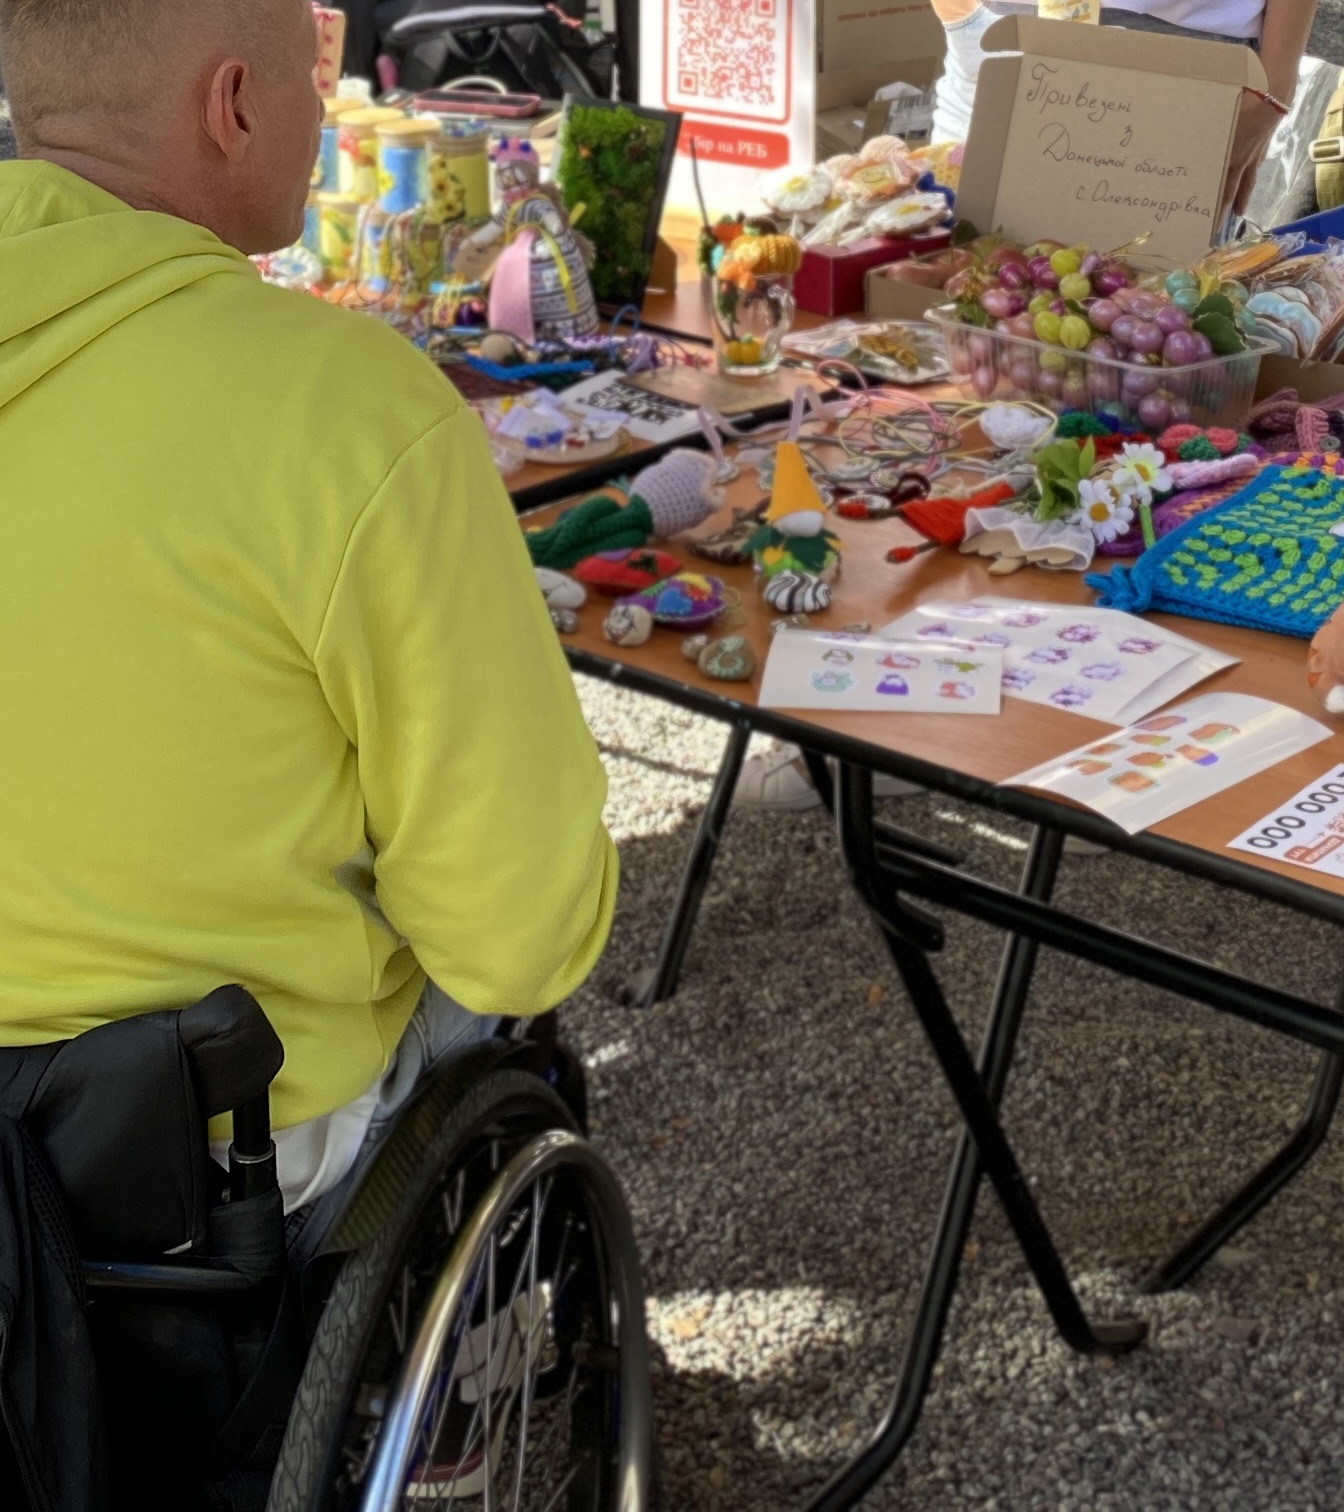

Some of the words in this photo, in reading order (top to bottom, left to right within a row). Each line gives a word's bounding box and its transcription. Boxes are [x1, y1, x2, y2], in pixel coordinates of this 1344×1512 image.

[1026, 62, 1131, 123] Привезені
[1119, 124, 1133, 147] з
[718, 141, 734, 153] на
[737, 140, 768, 158] РЕБ
[1134, 158, 1189, 177] області
[1246, 815, 1307, 849] 000
